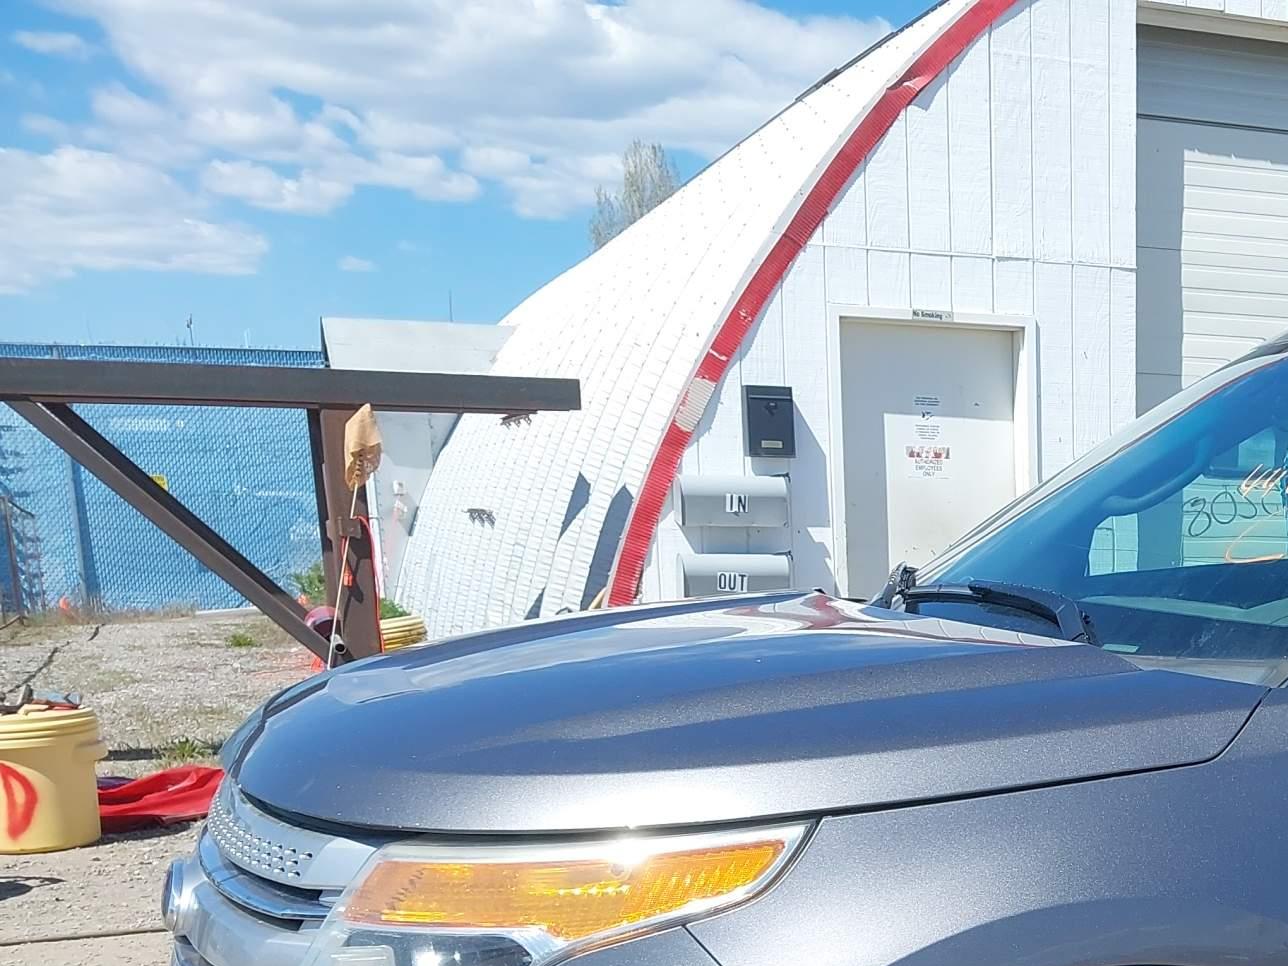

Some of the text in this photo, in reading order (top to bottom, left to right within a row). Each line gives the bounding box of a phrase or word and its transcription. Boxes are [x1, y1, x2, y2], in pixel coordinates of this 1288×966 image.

[921, 311, 943, 320] Smoking
[729, 495, 747, 513] IN
[718, 573, 747, 592] OUT
